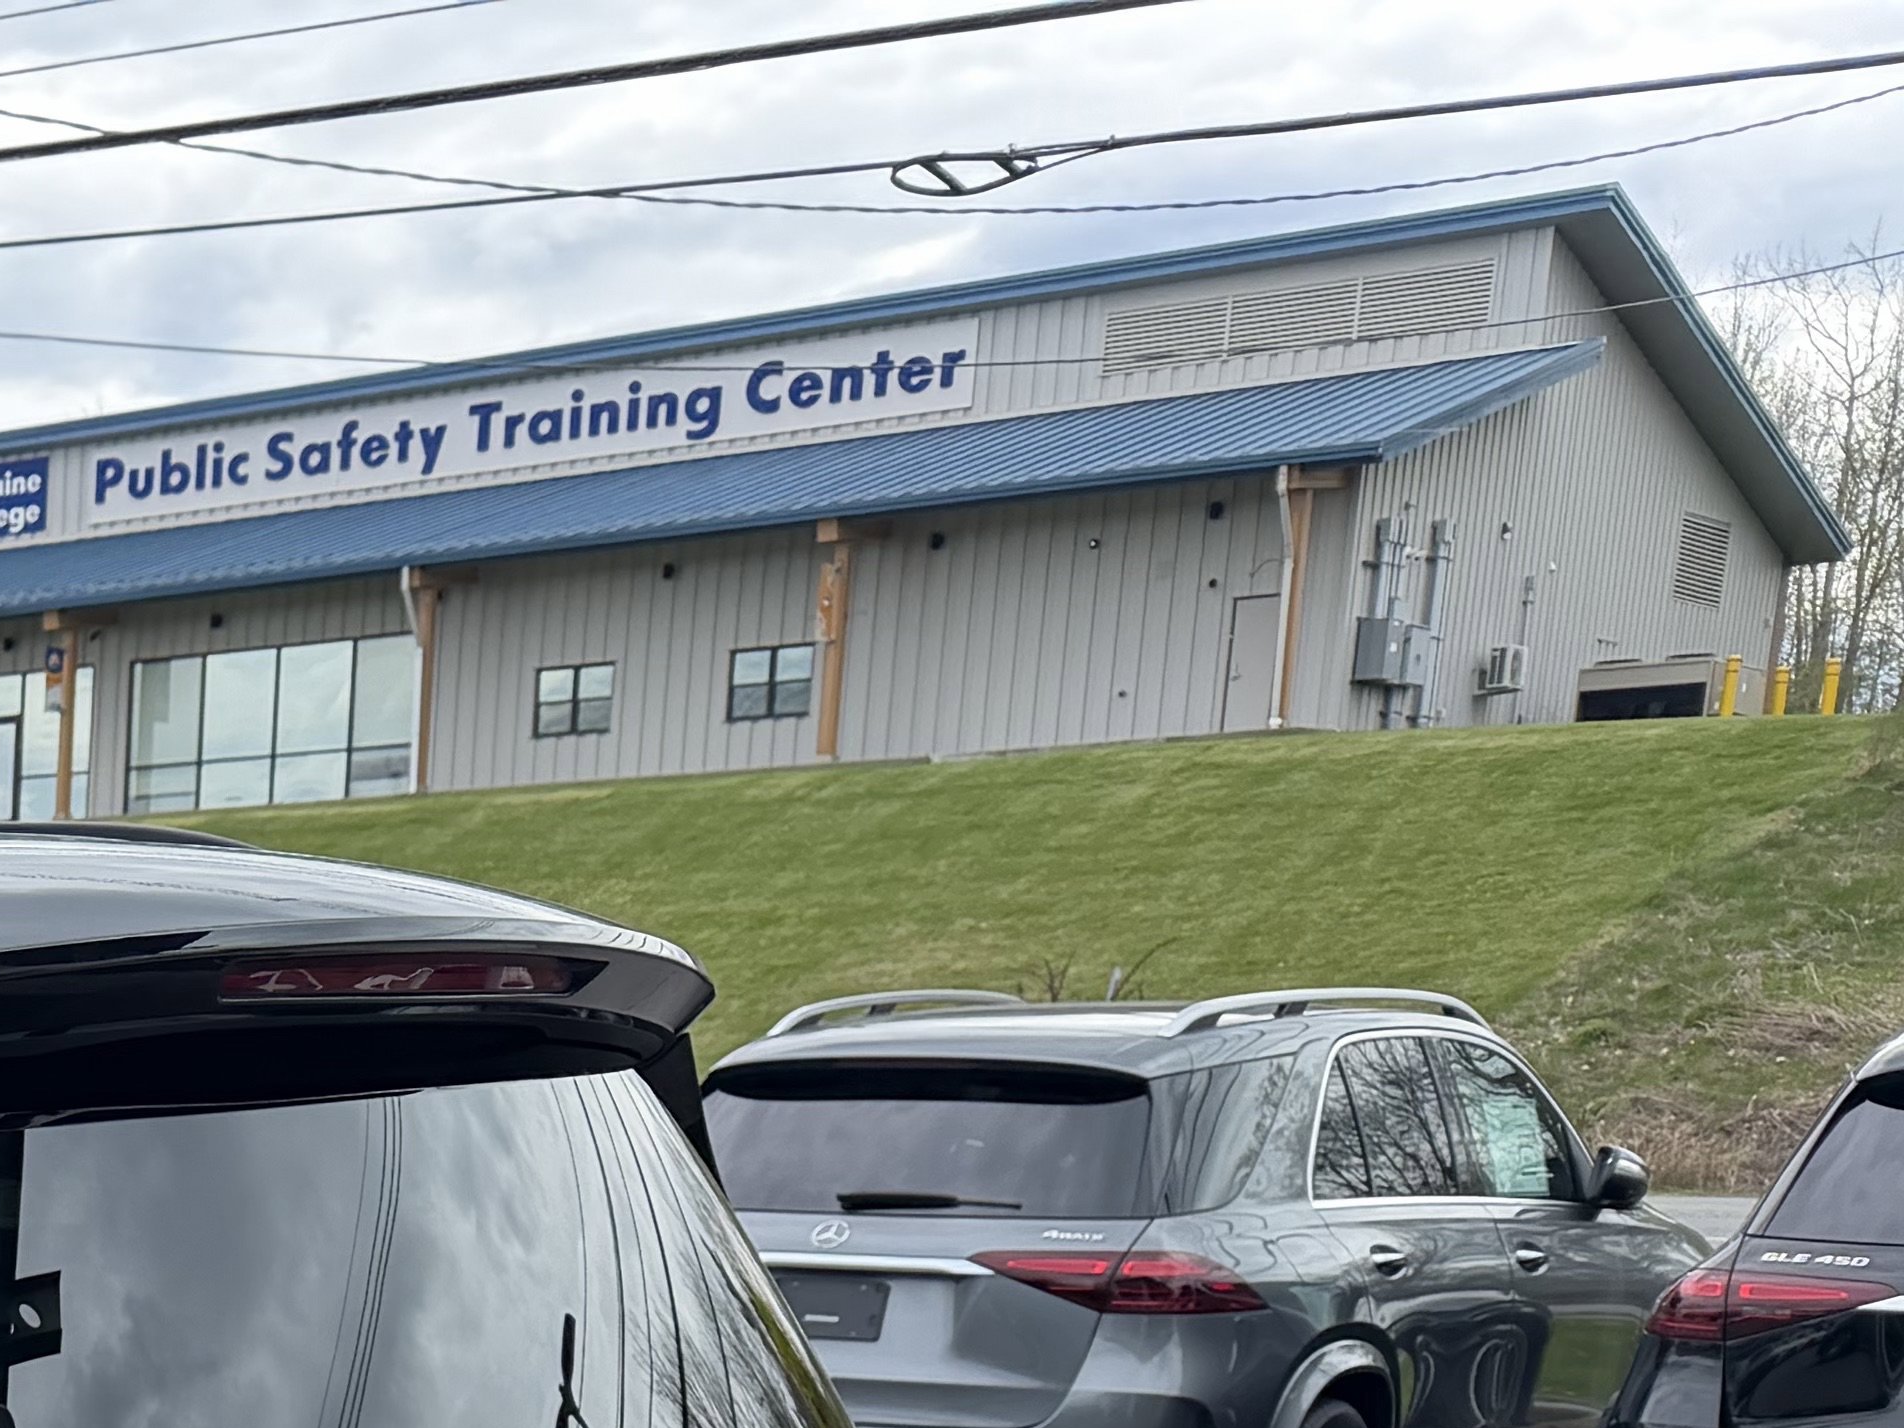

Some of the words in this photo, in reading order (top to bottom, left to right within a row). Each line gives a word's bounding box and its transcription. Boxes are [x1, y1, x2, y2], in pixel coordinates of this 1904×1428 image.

[93, 441, 250, 505] Public
[264, 420, 447, 480] Safety
[469, 380, 723, 454] Training
[745, 349, 967, 414] Center
[1760, 1251, 1812, 1263] GLE
[1814, 1254, 1871, 1267] 450
